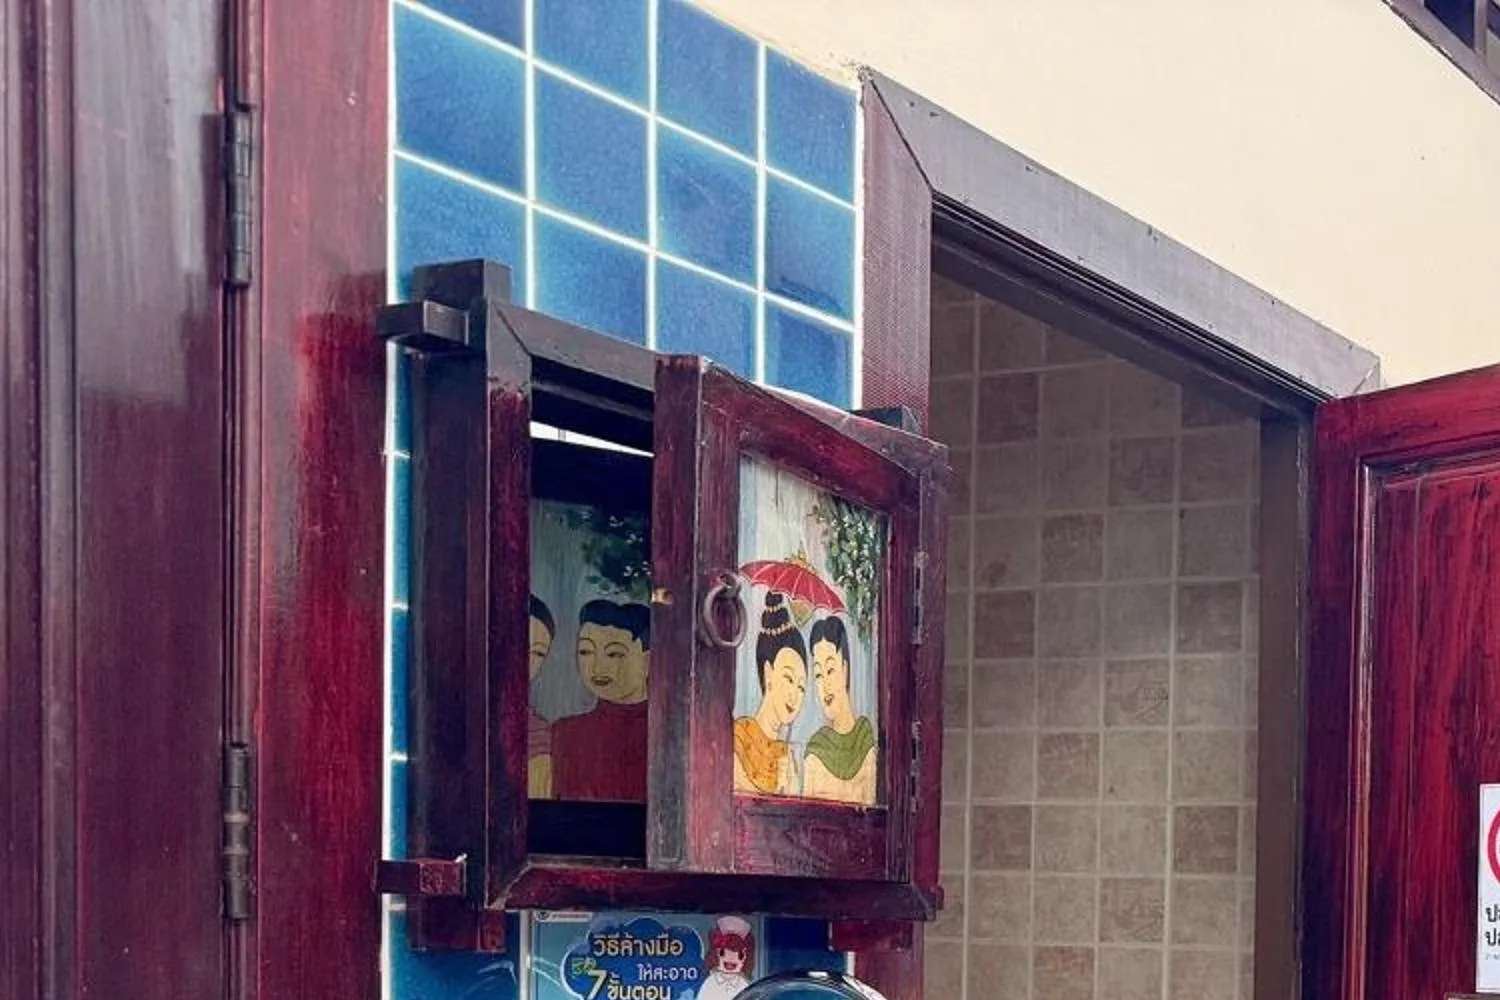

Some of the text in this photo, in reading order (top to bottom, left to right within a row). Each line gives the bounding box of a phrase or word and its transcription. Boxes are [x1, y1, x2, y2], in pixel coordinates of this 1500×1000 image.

[593, 932, 684, 957] วิธีล้างมือ
[586, 969, 671, 1000] 7 ขั้นตอน
[636, 963, 698, 981] ให้สะอาด
